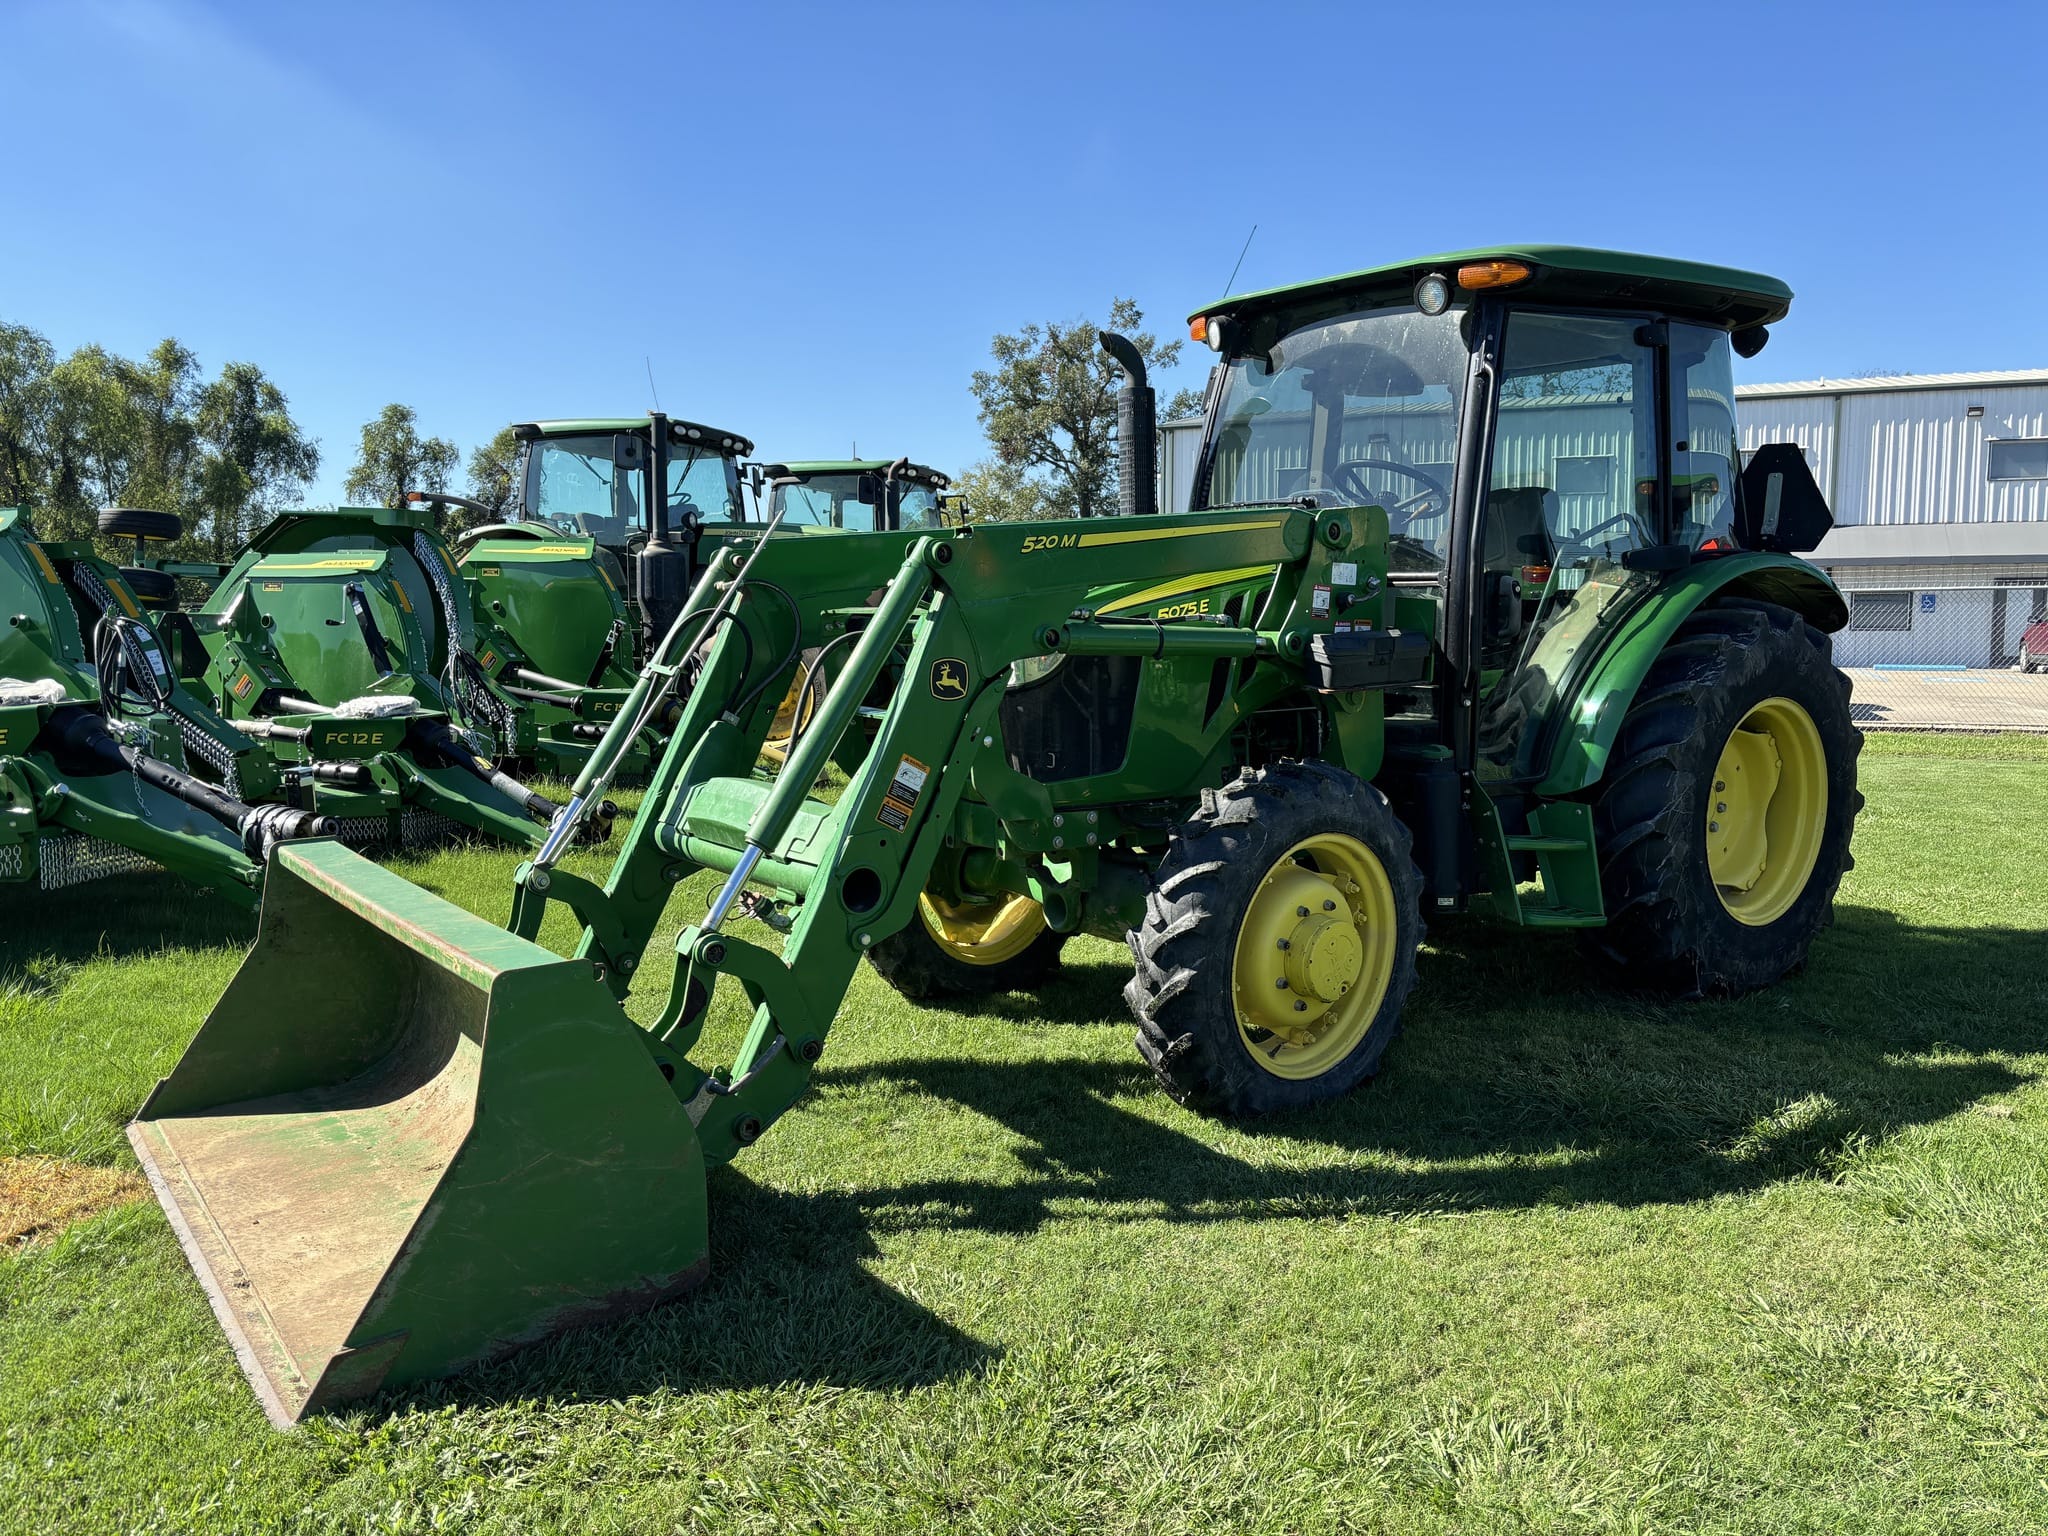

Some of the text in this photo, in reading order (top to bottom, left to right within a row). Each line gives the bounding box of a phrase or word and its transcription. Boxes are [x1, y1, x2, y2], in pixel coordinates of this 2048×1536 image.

[1021, 534, 1077, 554] 520 M
[1158, 598, 1210, 619] 5075 E
[593, 702, 613, 712] FC
